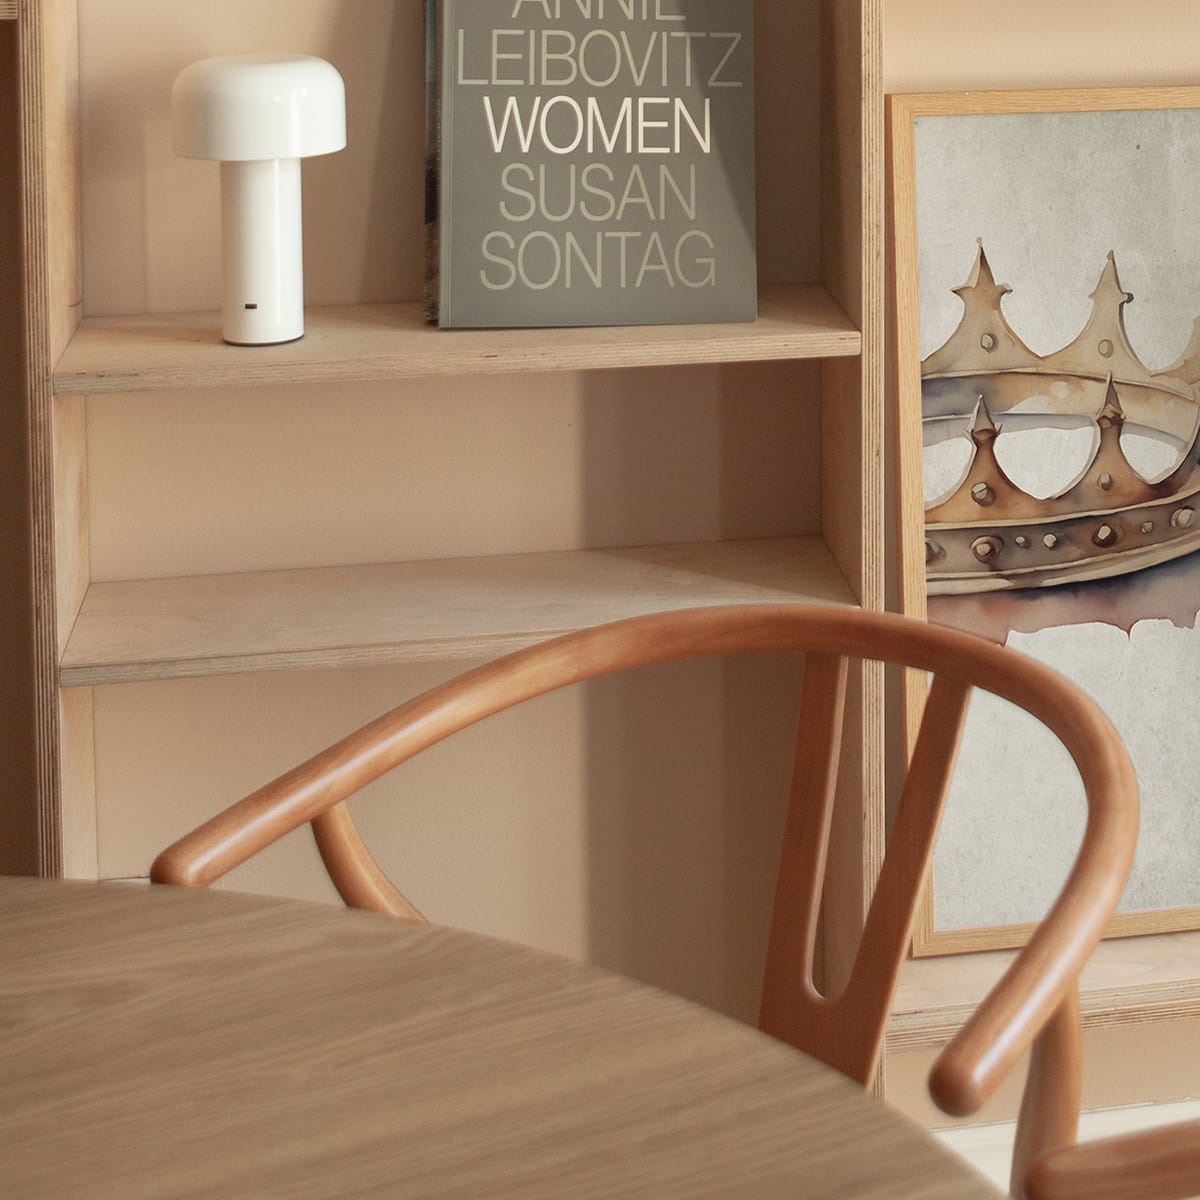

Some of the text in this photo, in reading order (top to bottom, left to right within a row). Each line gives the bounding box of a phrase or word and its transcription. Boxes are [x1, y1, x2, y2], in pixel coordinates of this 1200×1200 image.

[456, 28, 744, 88] LEIBOVITZ
[482, 95, 713, 155] WOMEN
[499, 161, 697, 223] SUSAN
[479, 228, 717, 292] SONTAG
